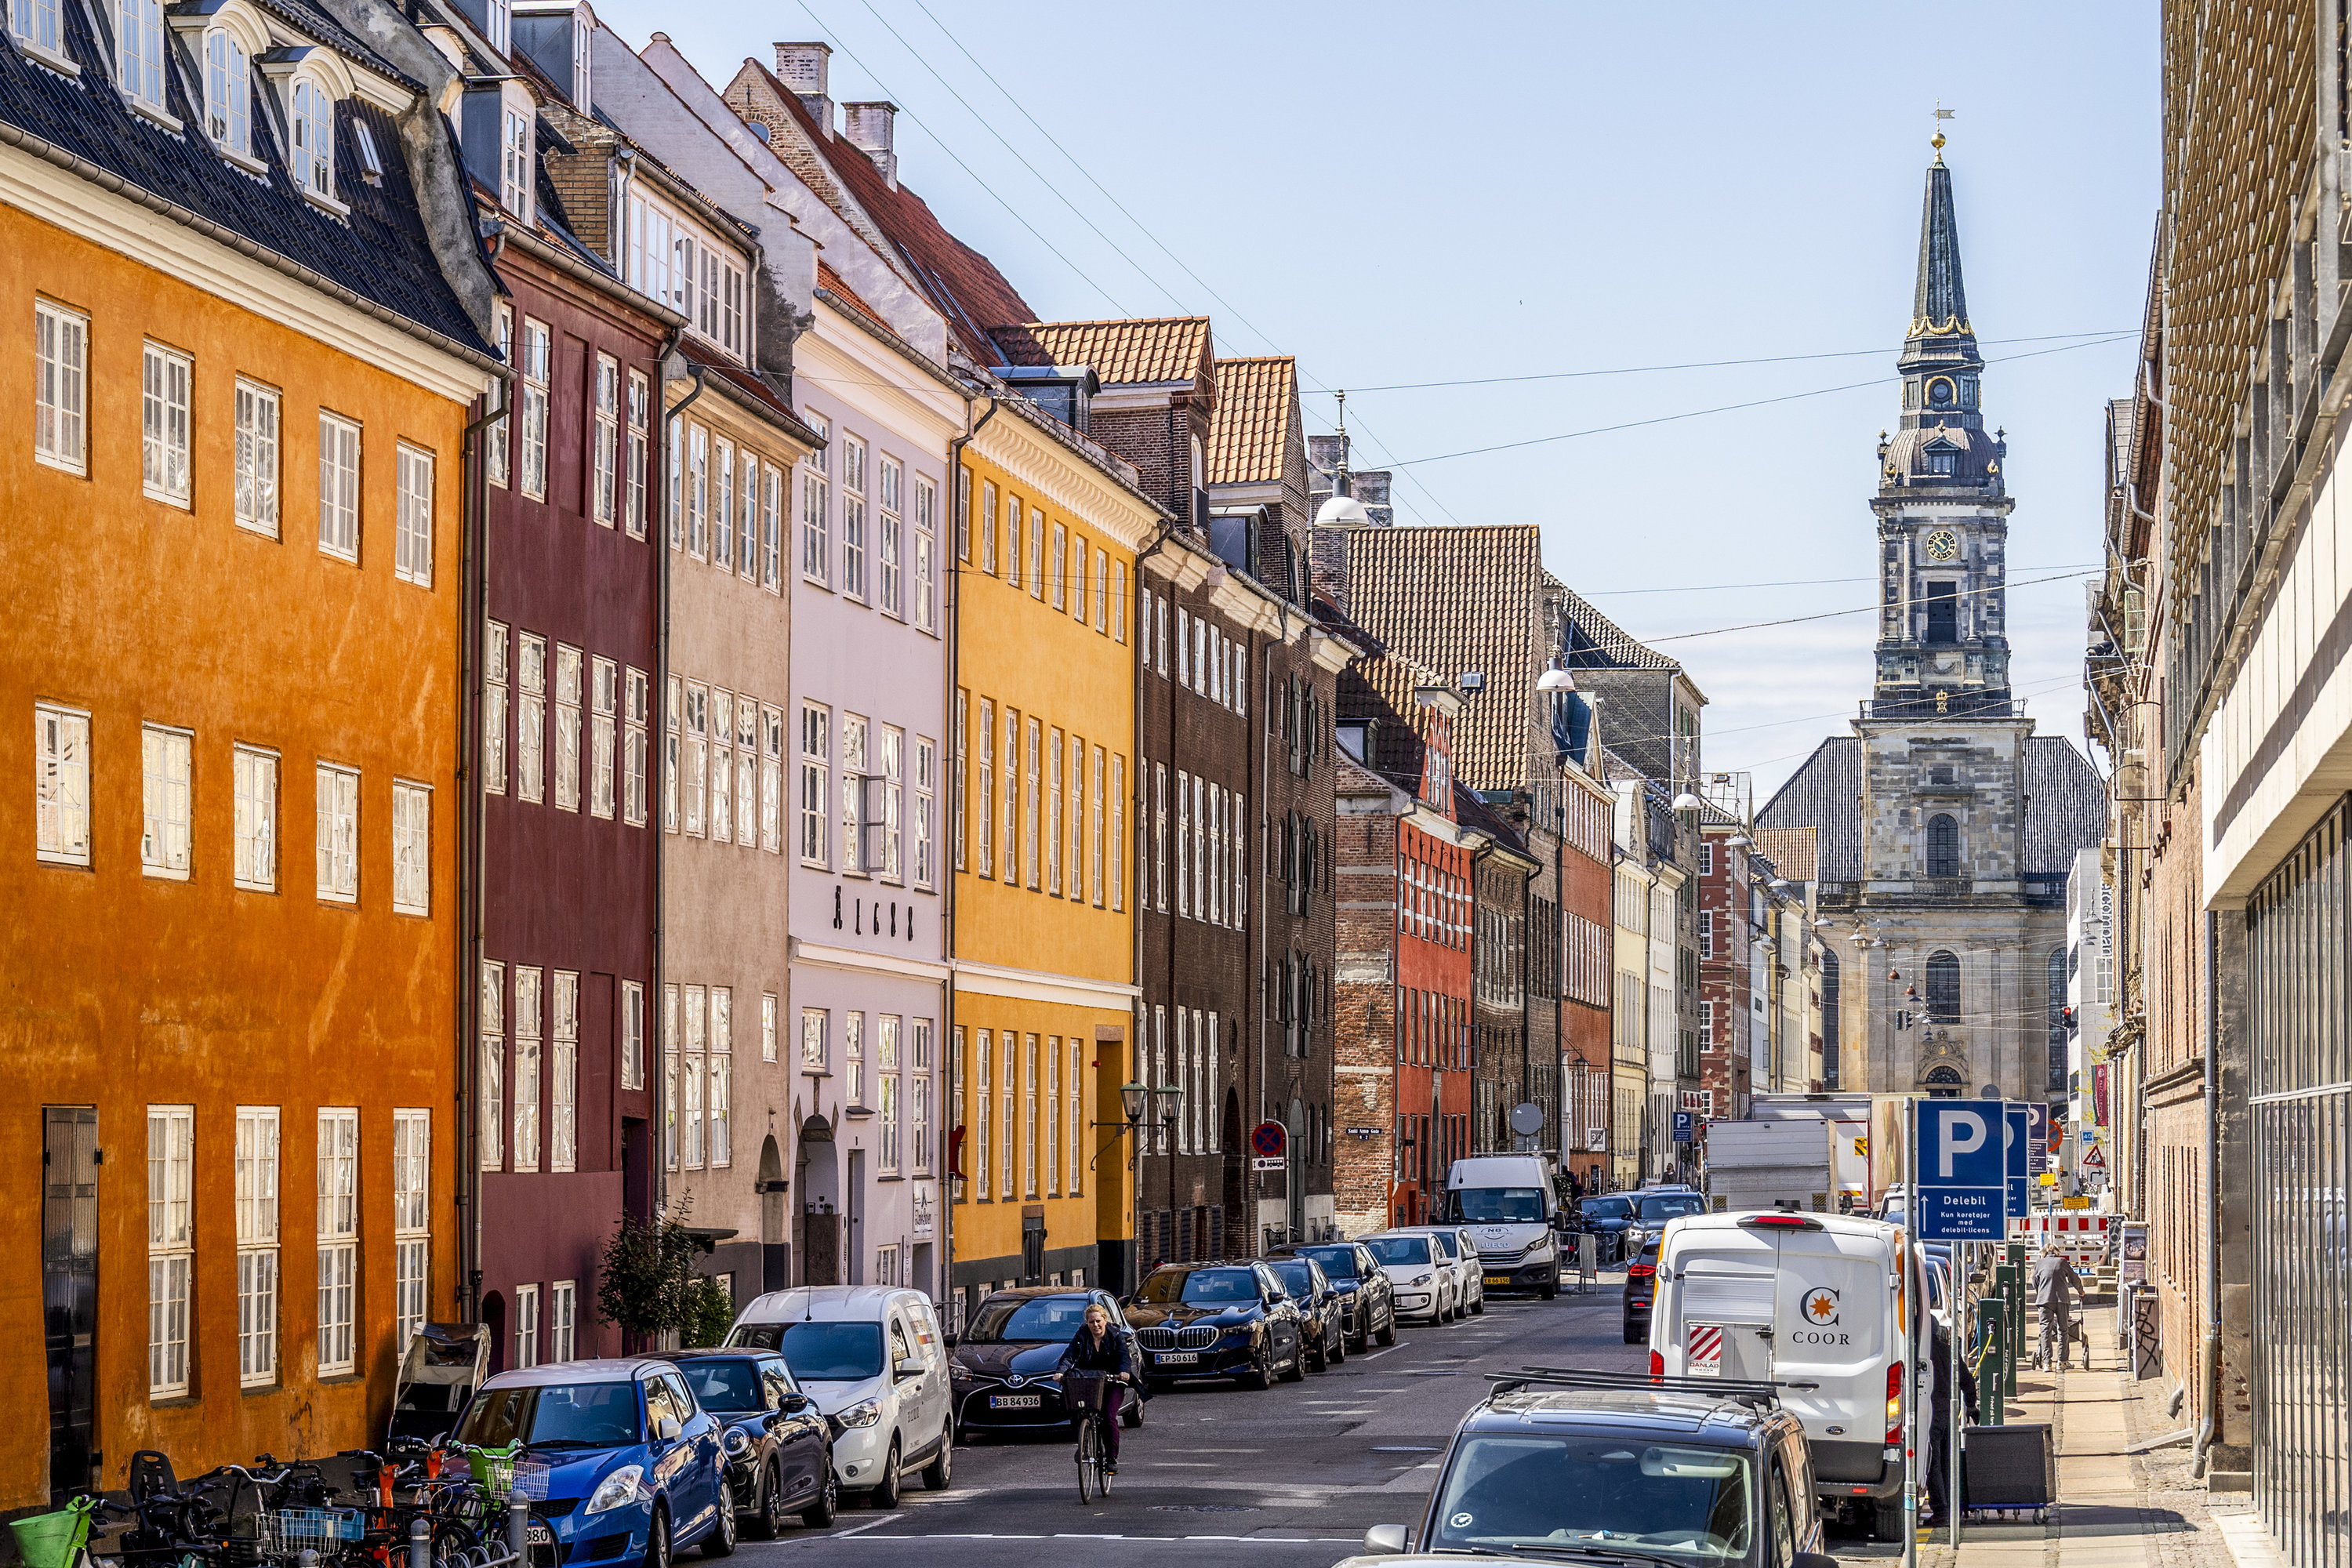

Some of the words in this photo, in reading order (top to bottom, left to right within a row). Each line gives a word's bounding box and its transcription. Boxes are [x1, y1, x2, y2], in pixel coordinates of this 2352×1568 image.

[1677, 1114, 1687, 1128] P
[1592, 1133, 1602, 1142] 30
[1939, 1109, 1987, 1178] P
[1944, 1196, 1986, 1205] Delebil
[1792, 1331, 1850, 1345] COOR
[1182, 1354, 1197, 1363] 616
